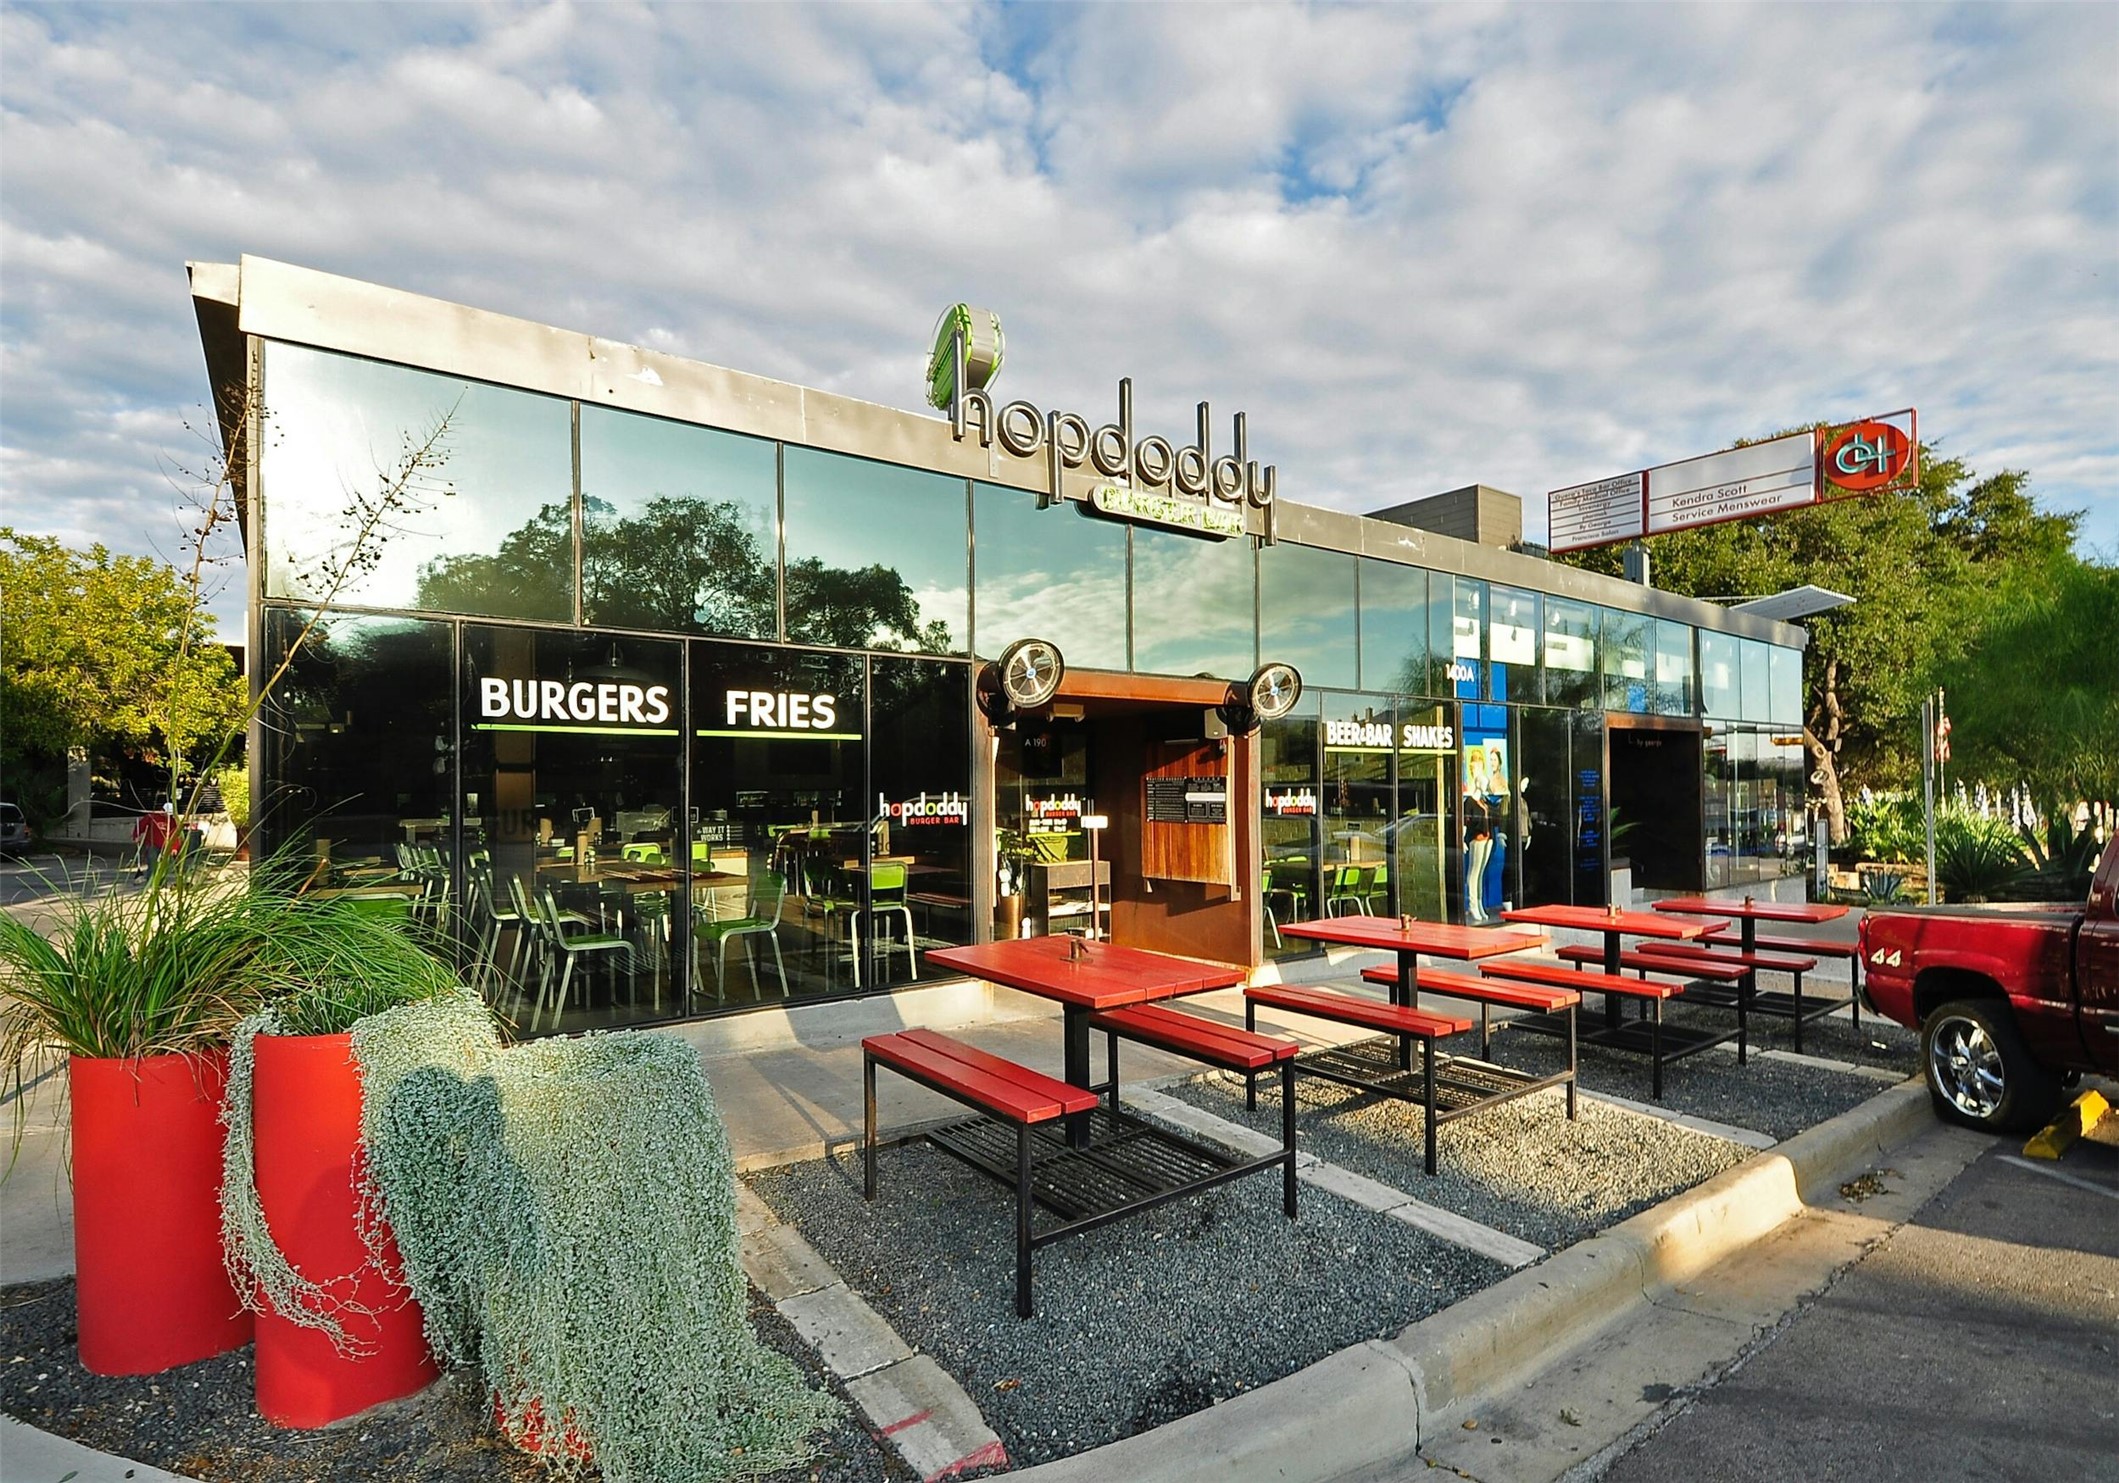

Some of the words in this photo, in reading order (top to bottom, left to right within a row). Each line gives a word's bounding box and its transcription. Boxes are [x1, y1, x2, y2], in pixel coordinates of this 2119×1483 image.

[952, 329, 1278, 546] hopdoddy
[1672, 493, 1714, 508] Kendra
[1717, 485, 1748, 499] Scott
[1672, 508, 1714, 522] Service
[1717, 495, 1782, 514] Menswear
[480, 677, 669, 724] BURGERS
[725, 689, 836, 730] FRIES
[1024, 738, 1032, 747] A
[1033, 737, 1047, 748] 190
[1403, 724, 1454, 748] SHAKES
[879, 791, 967, 827] hopdoddy
[1025, 793, 1081, 818] hopdoddy
[1265, 788, 1316, 815] hopdoddy
[702, 826, 717, 834] WAY
[717, 825, 725, 833] IT
[910, 817, 941, 825] BURGER
[943, 816, 959, 824] BAR
